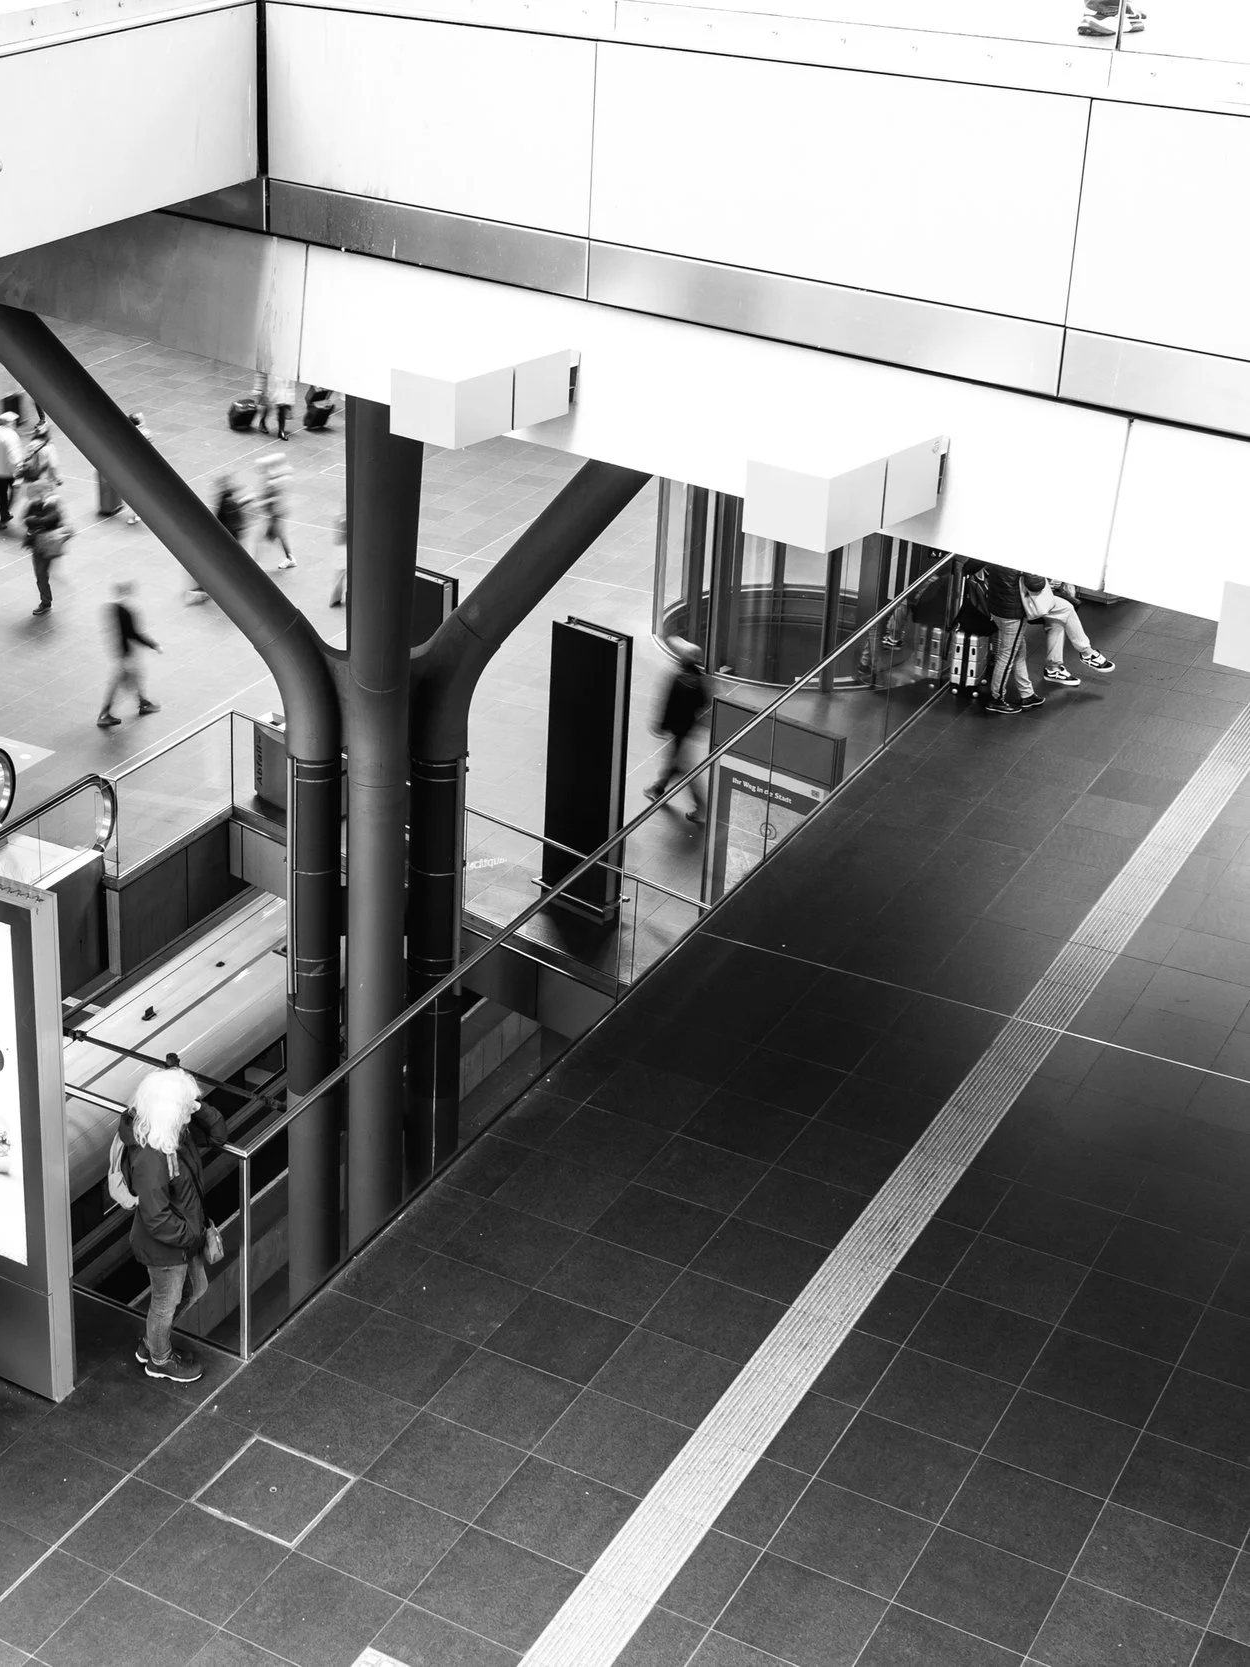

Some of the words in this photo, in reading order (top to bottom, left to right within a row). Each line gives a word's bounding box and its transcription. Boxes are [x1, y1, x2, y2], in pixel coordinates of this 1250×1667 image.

[732, 777, 742, 785] Ihr
[742, 780, 756, 793] Weg
[756, 785, 763, 794] in
[763, 787, 773, 798] de
[774, 792, 792, 804] Stadt
